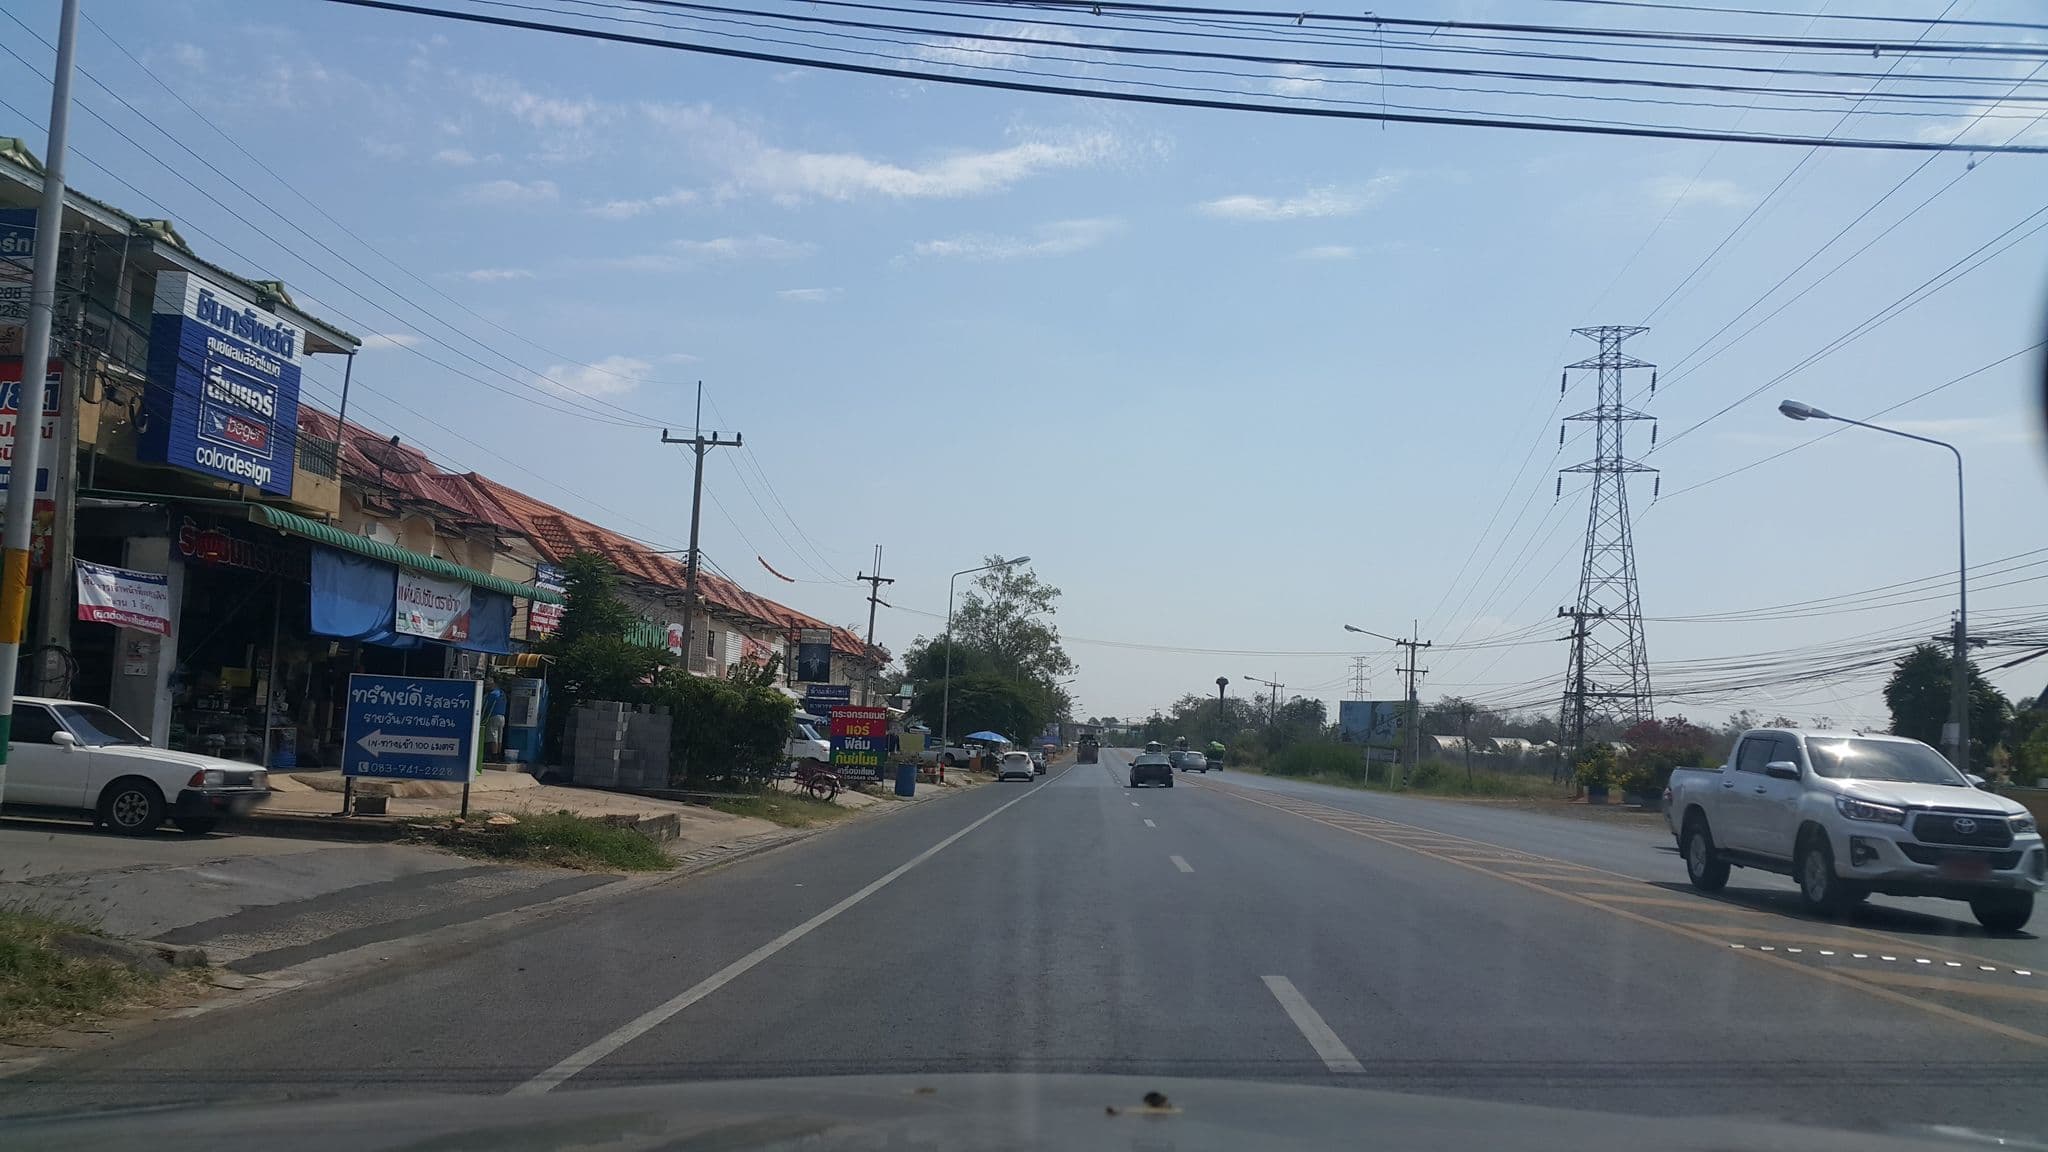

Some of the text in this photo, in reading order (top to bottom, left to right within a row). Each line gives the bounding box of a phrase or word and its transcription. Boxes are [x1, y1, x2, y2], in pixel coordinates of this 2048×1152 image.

[195, 446, 271, 486] colordesign
[351, 683, 471, 709] ทรัพย์ดี รีสอร์ท
[832, 710, 886, 720] กระจกรถยนต์
[846, 722, 871, 736] แอร์
[844, 736, 871, 750] ฟิล์ม
[835, 751, 878, 765] กันขโมย
